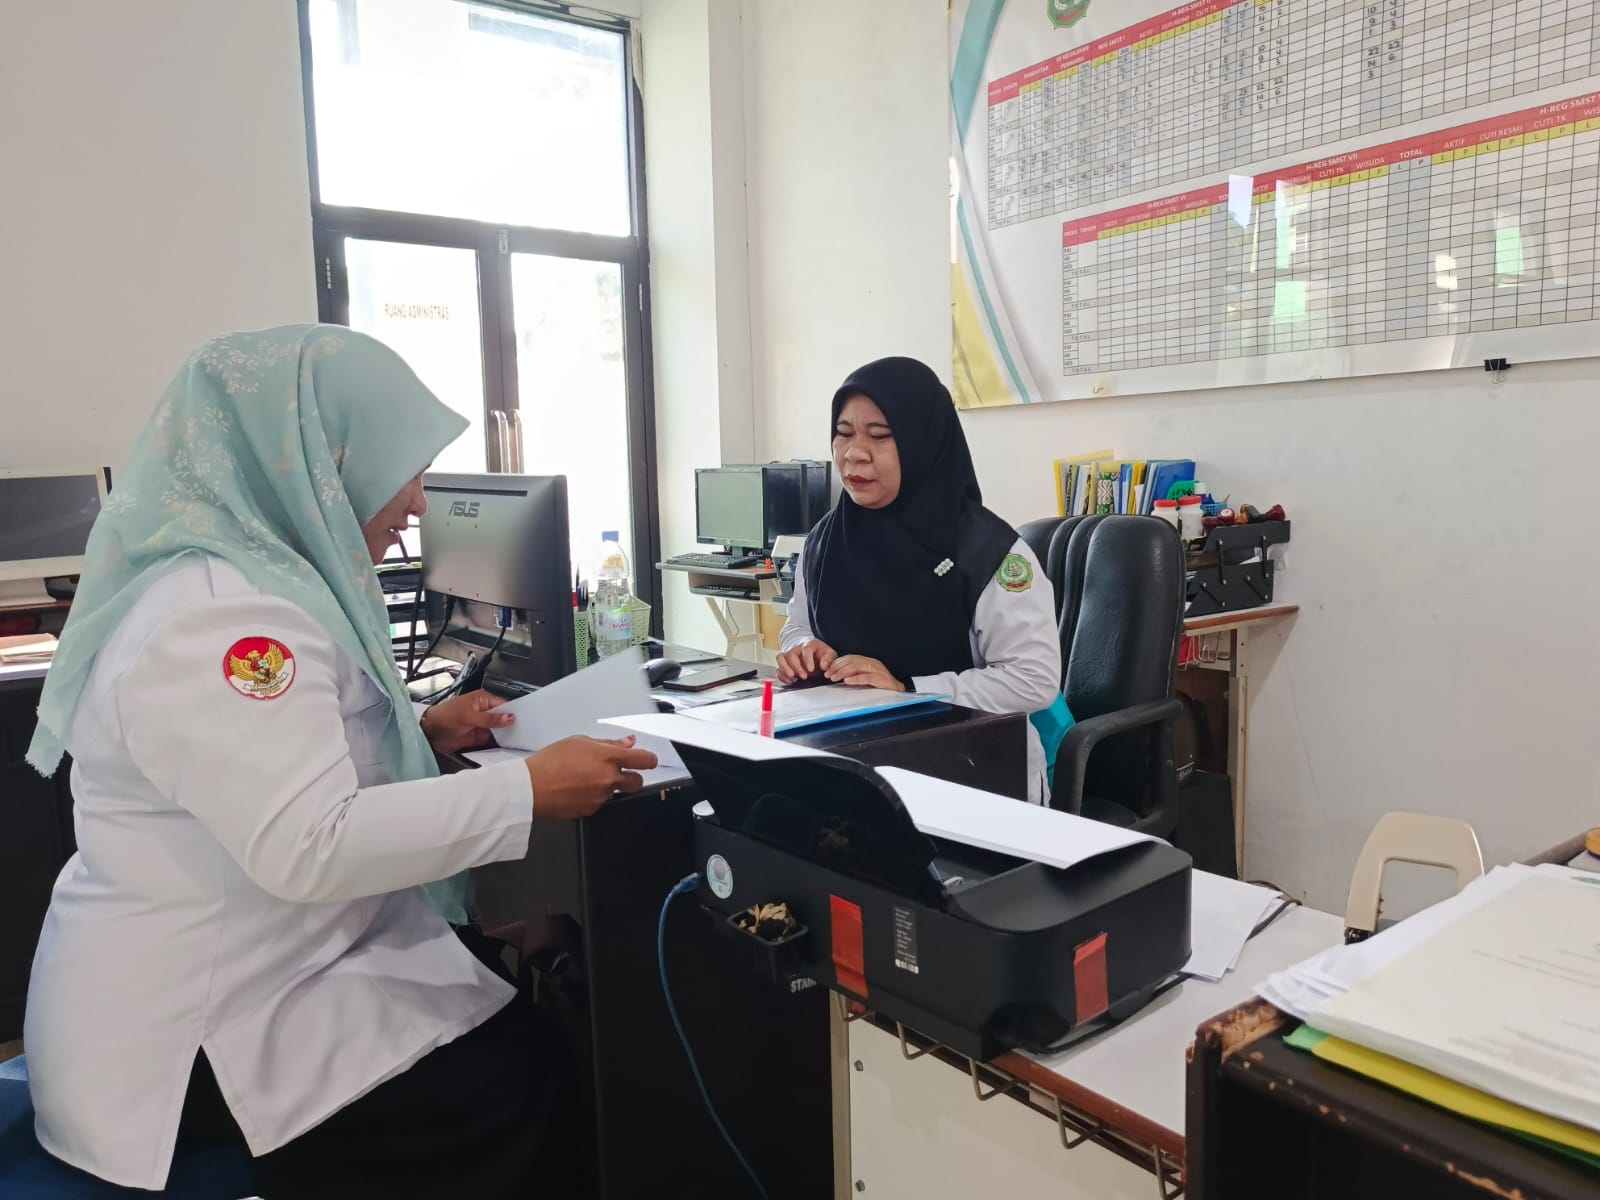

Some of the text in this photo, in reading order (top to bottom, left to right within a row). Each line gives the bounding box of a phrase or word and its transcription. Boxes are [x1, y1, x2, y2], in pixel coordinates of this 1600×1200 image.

[1368, 6, 1376, 15] 10
[1540, 104, 1568, 116] H-REG
[1570, 96, 1595, 108] SMST
[1444, 138, 1465, 149] AKTIF
[1480, 132, 1497, 141] CUTI
[1499, 125, 1522, 137] RESMI
[1533, 118, 1554, 129] CUTI
[1556, 114, 1567, 122] TK
[1319, 168, 1334, 178] CUTI
[1356, 157, 1385, 169] WISUDA
[1399, 149, 1423, 159] TOTAL
[1328, 156, 1348, 166] SMST
[448, 501, 480, 518] ASUS
